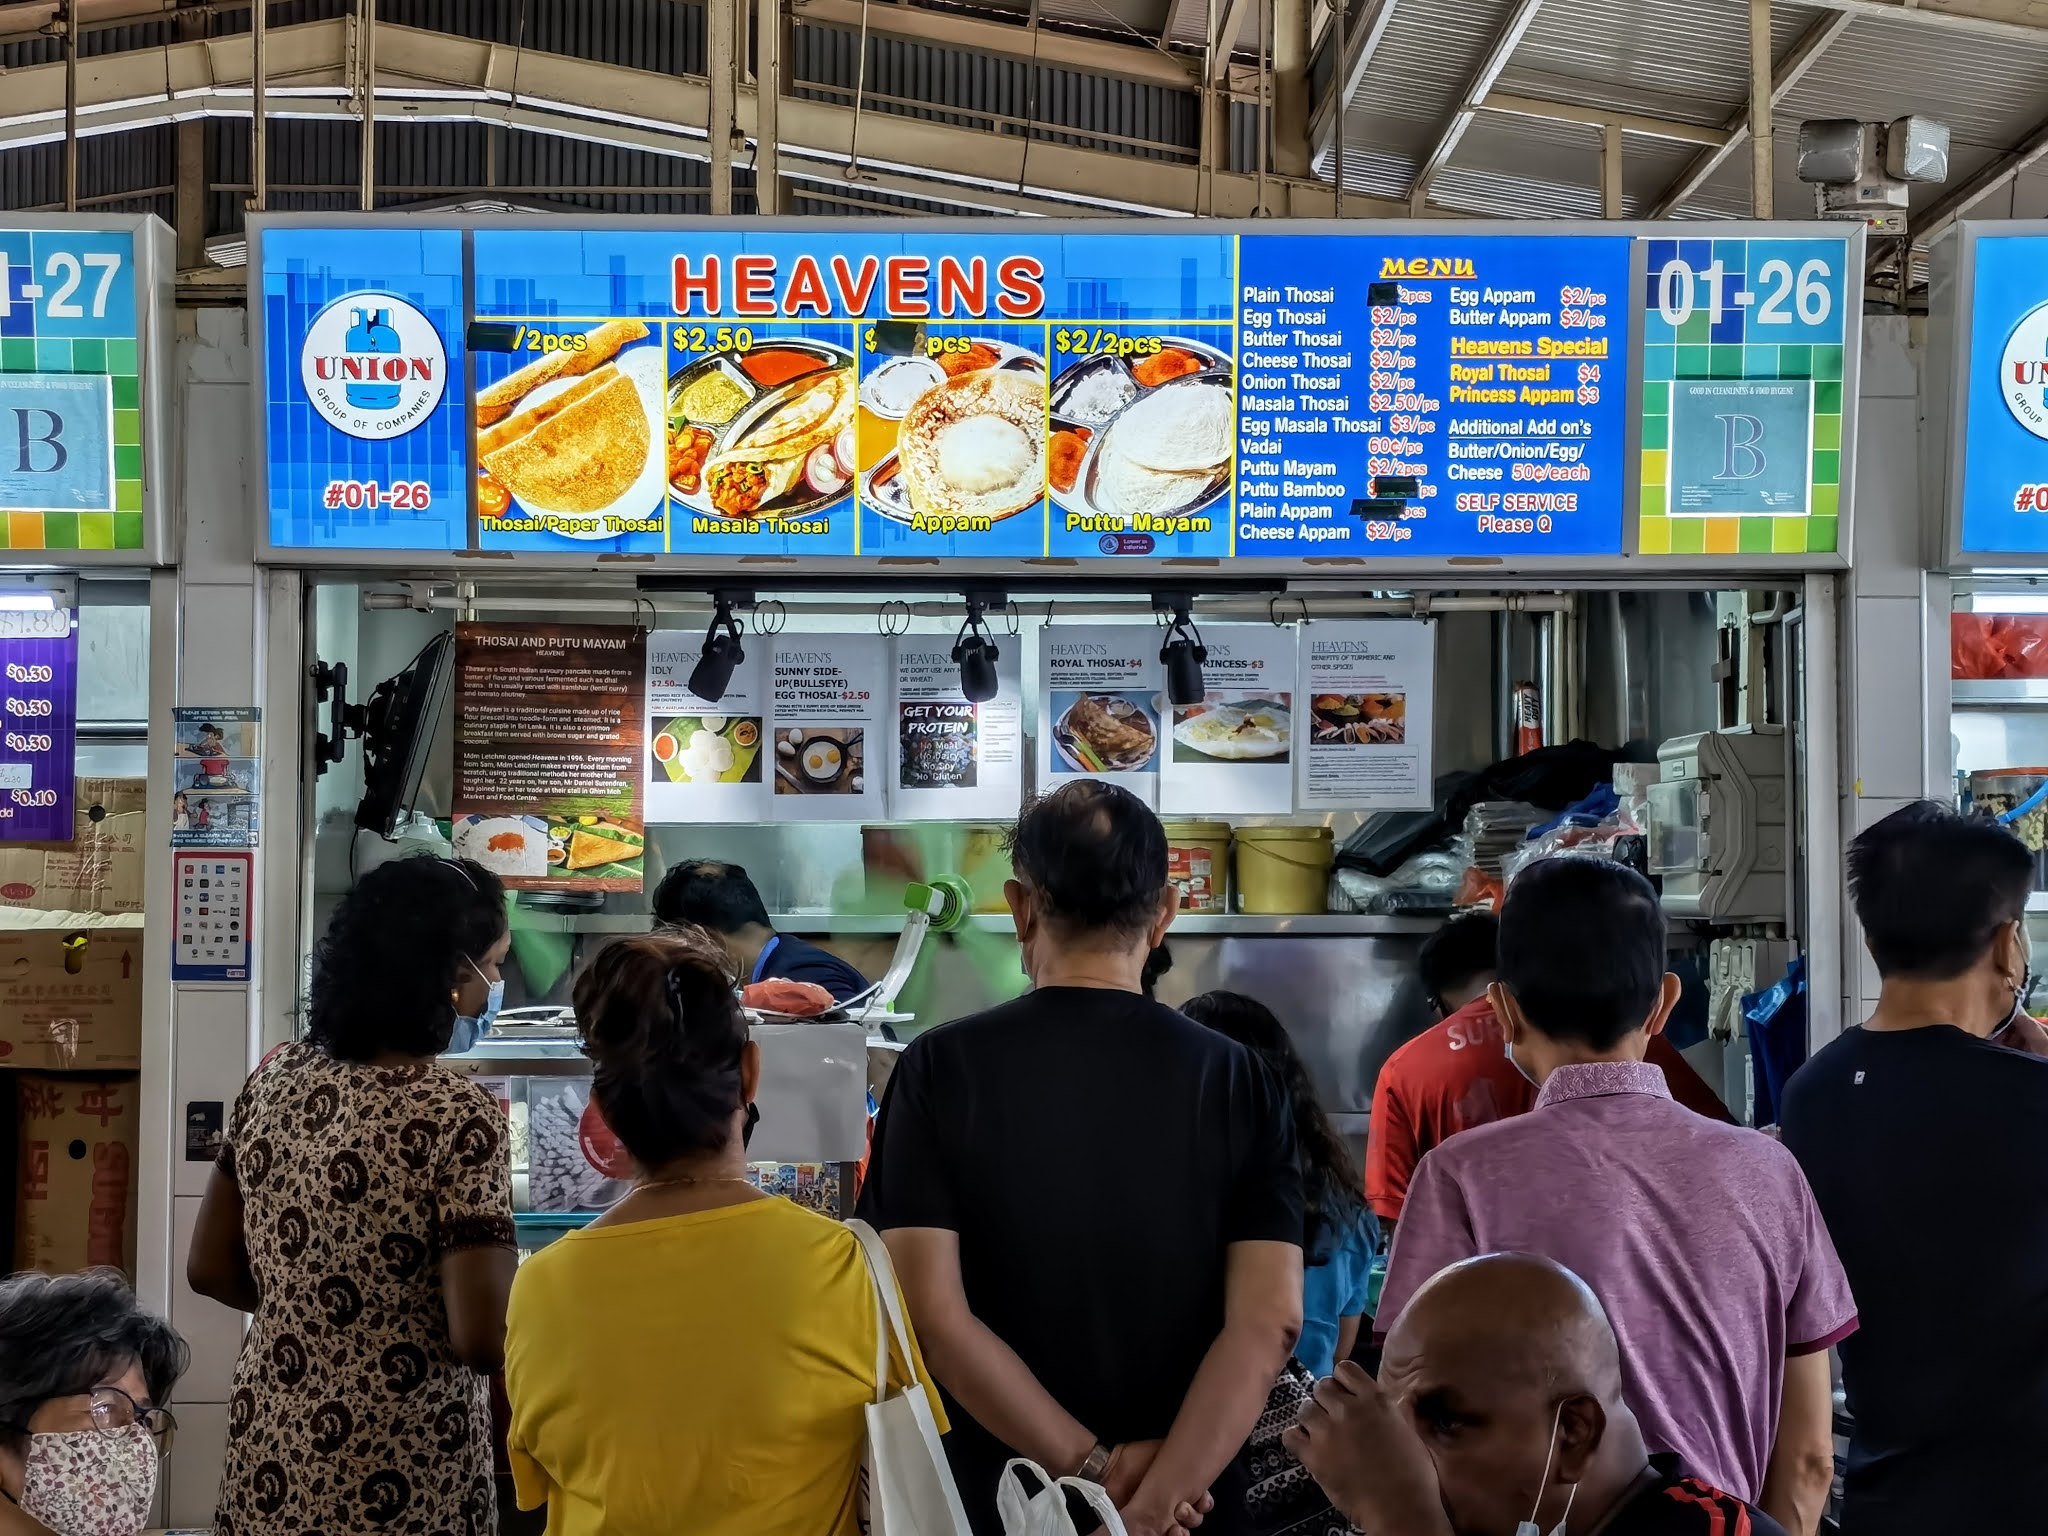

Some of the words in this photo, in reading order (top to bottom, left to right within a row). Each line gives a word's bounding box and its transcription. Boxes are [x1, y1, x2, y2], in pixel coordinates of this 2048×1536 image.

[1379, 257, 1475, 276] MENU
[671, 254, 1045, 317] HEAVENS
[1244, 287, 1280, 303] Plain
[1285, 287, 1334, 303] Thosai
[1659, 259, 1831, 326] 01-26
[1451, 287, 1479, 306] Egg
[1483, 287, 1535, 306] Appam
[1561, 286, 1606, 307] $2/pc
[1243, 309, 1272, 328] Egg
[1276, 309, 1326, 325] Thosai
[1371, 306, 1416, 326] $2/pc
[1450, 309, 1495, 325] Butter
[1499, 309, 1551, 327] Appam
[1560, 307, 1606, 329] $2/pc
[512, 325, 588, 355] /2pcs
[672, 326, 754, 352] $2.50
[1055, 328, 1162, 355] $2/2pcs
[1243, 331, 1288, 347] Butter
[1292, 331, 1342, 347] Thosai
[1371, 328, 1416, 348] $2/pc
[1451, 337, 1533, 356] Heavens
[1537, 337, 1608, 358] Special
[314, 356, 434, 381] UNION
[1242, 353, 1298, 369] Cheese
[1302, 353, 1351, 369] Thosai
[1370, 350, 1416, 370] $2/pc
[1242, 374, 1286, 390] Onion
[1291, 374, 1340, 390] Thosai
[1370, 371, 1415, 391] $2/pc
[1450, 364, 1493, 384] Royal
[1497, 364, 1550, 381] Thosai
[1578, 363, 1600, 383] $4
[1450, 386, 1516, 403] Princess
[1520, 386, 1574, 406] Appam
[1577, 386, 1600, 406] $3
[1690, 387, 1704, 395] GOOD
[317, 387, 347, 419] GROUP
[353, 419, 369, 430] OF
[377, 390, 431, 431] COMPANIES
[1242, 396, 1294, 411] Masala
[1300, 396, 1349, 411] Thosai
[1370, 393, 1440, 413] $2.50/pc
[2014, 392, 2042, 425] GROUP
[1242, 417, 1270, 436] Egg
[1275, 417, 1327, 433] Masala
[1332, 417, 1381, 433] Thosai
[1390, 414, 1436, 434] $3/pc
[1449, 419, 1523, 435] Additional
[1527, 419, 1558, 435] Add
[1561, 419, 1592, 435] on's
[9, 408, 68, 474] B
[1241, 439, 1282, 454] Vadai
[1368, 436, 1423, 456] 60¢/pc
[1713, 414, 1766, 480] B
[1448, 443, 1585, 462] Butter/Onion/Egg/
[1241, 460, 1278, 476] Puttu
[1284, 460, 1336, 479] Mayam
[1368, 457, 1427, 477] $2/2pcs
[1448, 464, 1503, 480] Cheese
[1512, 463, 1590, 482] 50¢/each
[323, 480, 431, 511] #01-26
[1240, 481, 1278, 497] Puttu
[1283, 481, 1345, 497] Bamboo
[1240, 503, 1276, 519] Plain
[1285, 503, 1332, 521] Appam
[1456, 493, 1499, 511] SELF
[1504, 493, 1577, 511] SERVICE
[480, 515, 599, 533] Thosai/Paper
[603, 515, 665, 533] Thosai
[692, 517, 760, 534] Masala
[766, 517, 830, 534] Thosai
[911, 512, 992, 533] Appam
[1066, 513, 1125, 532] Puttu
[1131, 513, 1211, 533] Mayam
[1240, 524, 1294, 540] Cheese
[1299, 524, 1350, 542] Appam
[1366, 521, 1411, 541] $2/pc
[1478, 515, 1533, 533] Please
[1538, 515, 1552, 533] Q
[475, 636, 518, 646] THOSAI
[521, 637, 546, 647] AND
[549, 638, 580, 648] PUTU
[583, 639, 626, 649] MAYAM
[6, 663, 52, 682] $0.30
[652, 666, 673, 674] IDLY
[775, 668, 810, 676] SUNNY
[813, 668, 842, 676] SIDE-
[1051, 659, 1084, 667] ROYAL
[1203, 660, 1264, 669] RINCESS-$3
[652, 680, 675, 688] $2.50
[775, 679, 848, 689] UP(BULLSEYE)
[6, 698, 52, 717] $0.30
[904, 706, 933, 718] GET
[935, 706, 974, 718] YOUR
[1524, 693, 1533, 723] HEAVY
[908, 722, 969, 734] PROTEIN
[6, 733, 51, 752] $0.30
[11, 788, 57, 807] $0.10
